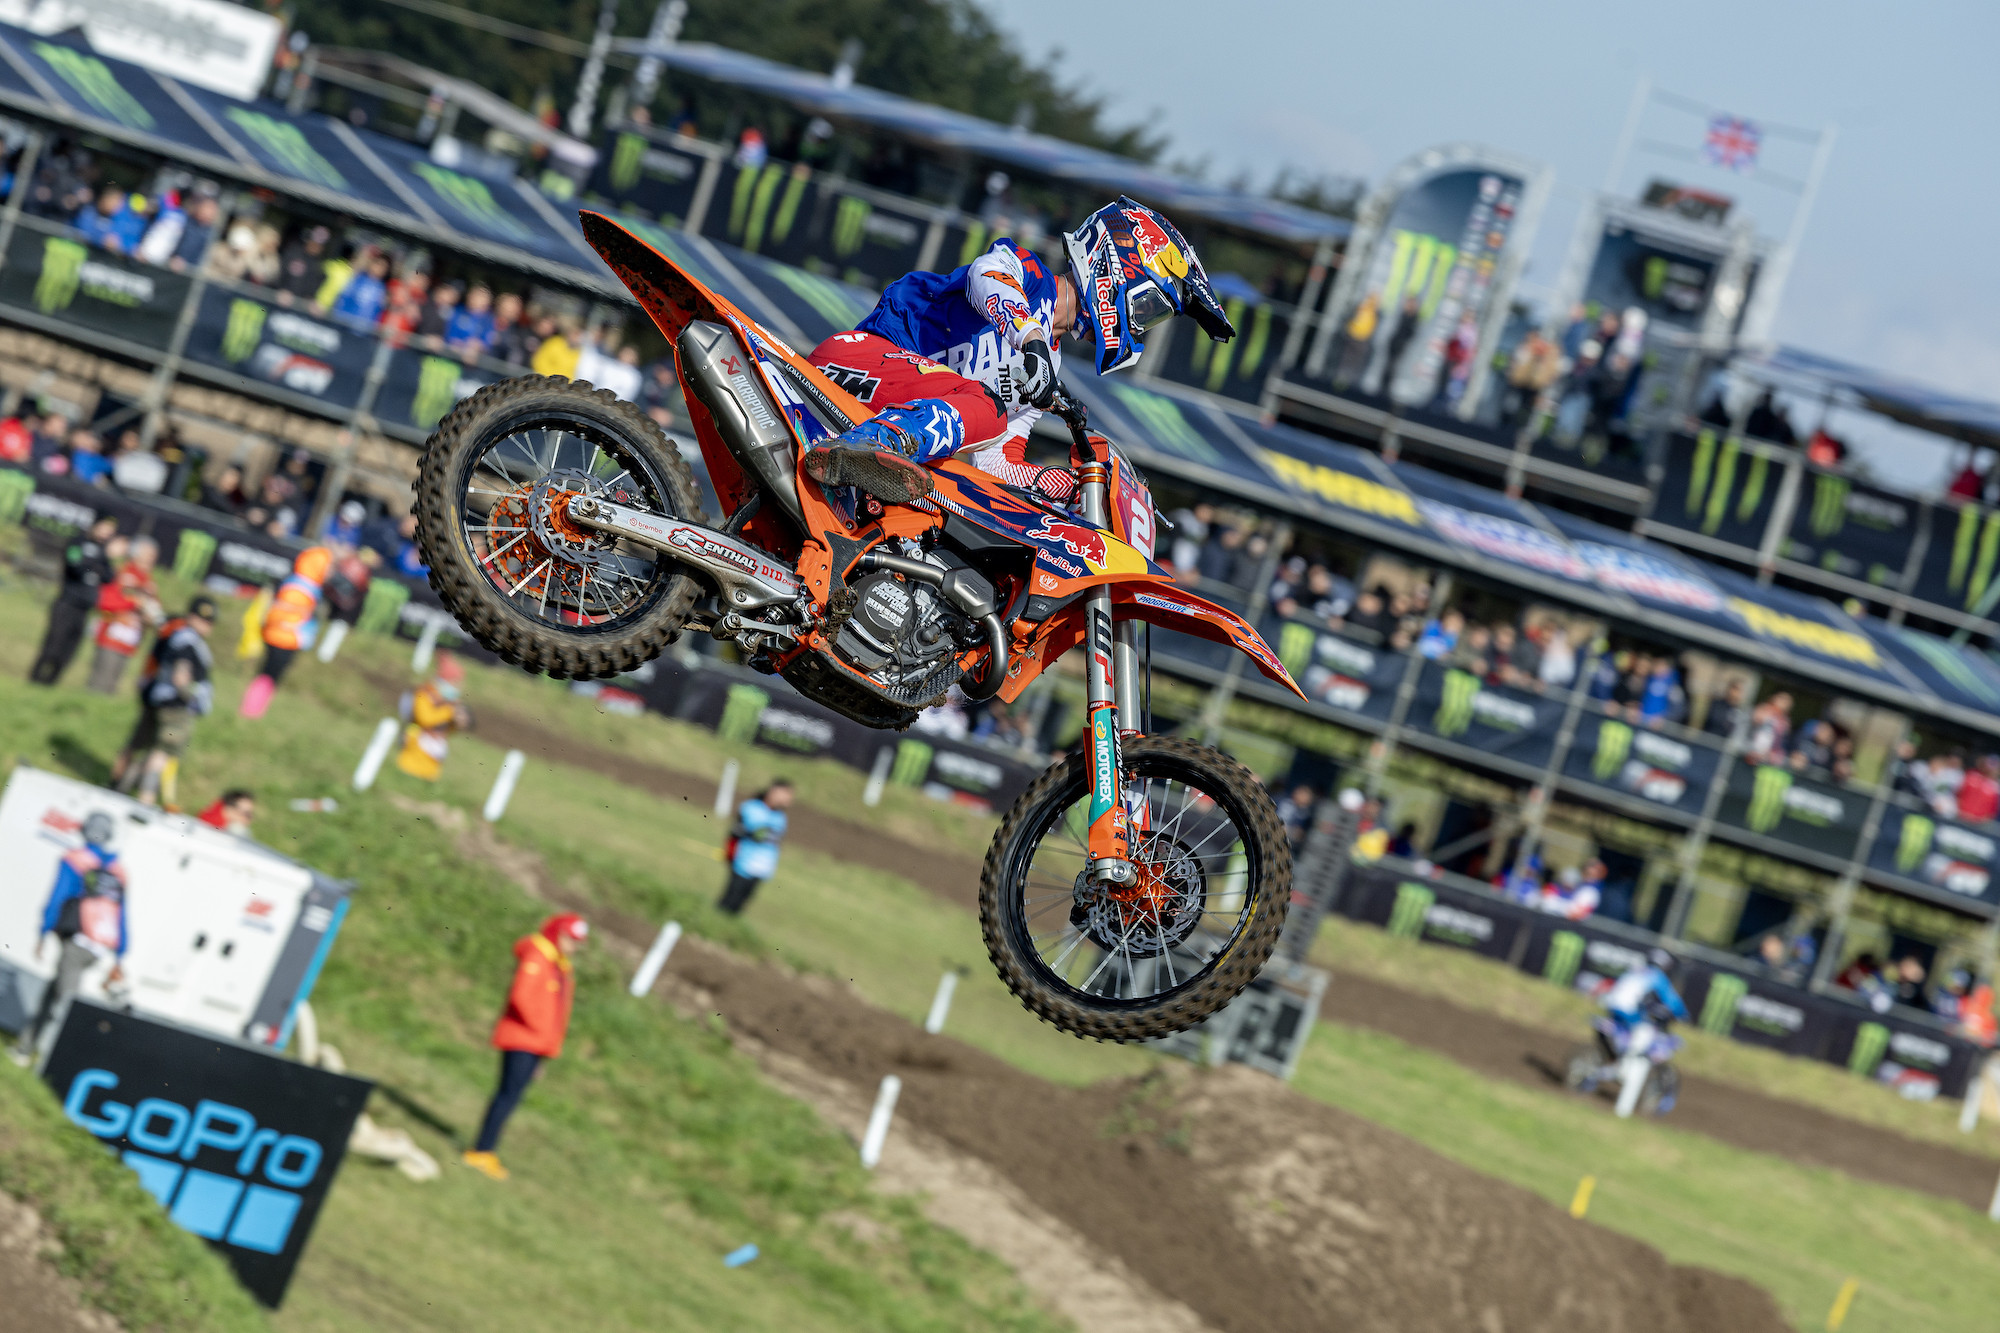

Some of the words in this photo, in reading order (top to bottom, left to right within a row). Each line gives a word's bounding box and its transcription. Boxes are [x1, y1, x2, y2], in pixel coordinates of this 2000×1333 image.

[731, 374, 777, 430] AKRAPOVIČ
[785, 362, 804, 381] LOMA
[800, 377, 820, 397] LINDA
[816, 392, 850, 425] UNIVERSITY
[998, 364, 1013, 402] THOR
[638, 521, 663, 535] brembo
[1130, 497, 1151, 560] 2
[1038, 549, 1061, 567] Red
[1059, 558, 1083, 578] Bull
[871, 586, 910, 613] FACTORY
[877, 580, 910, 604] KTM
[1138, 595, 1188, 614] PROGRESSIVE
[1096, 740, 1113, 805] MOTOREX
[64, 1067, 324, 1188] GoPro
